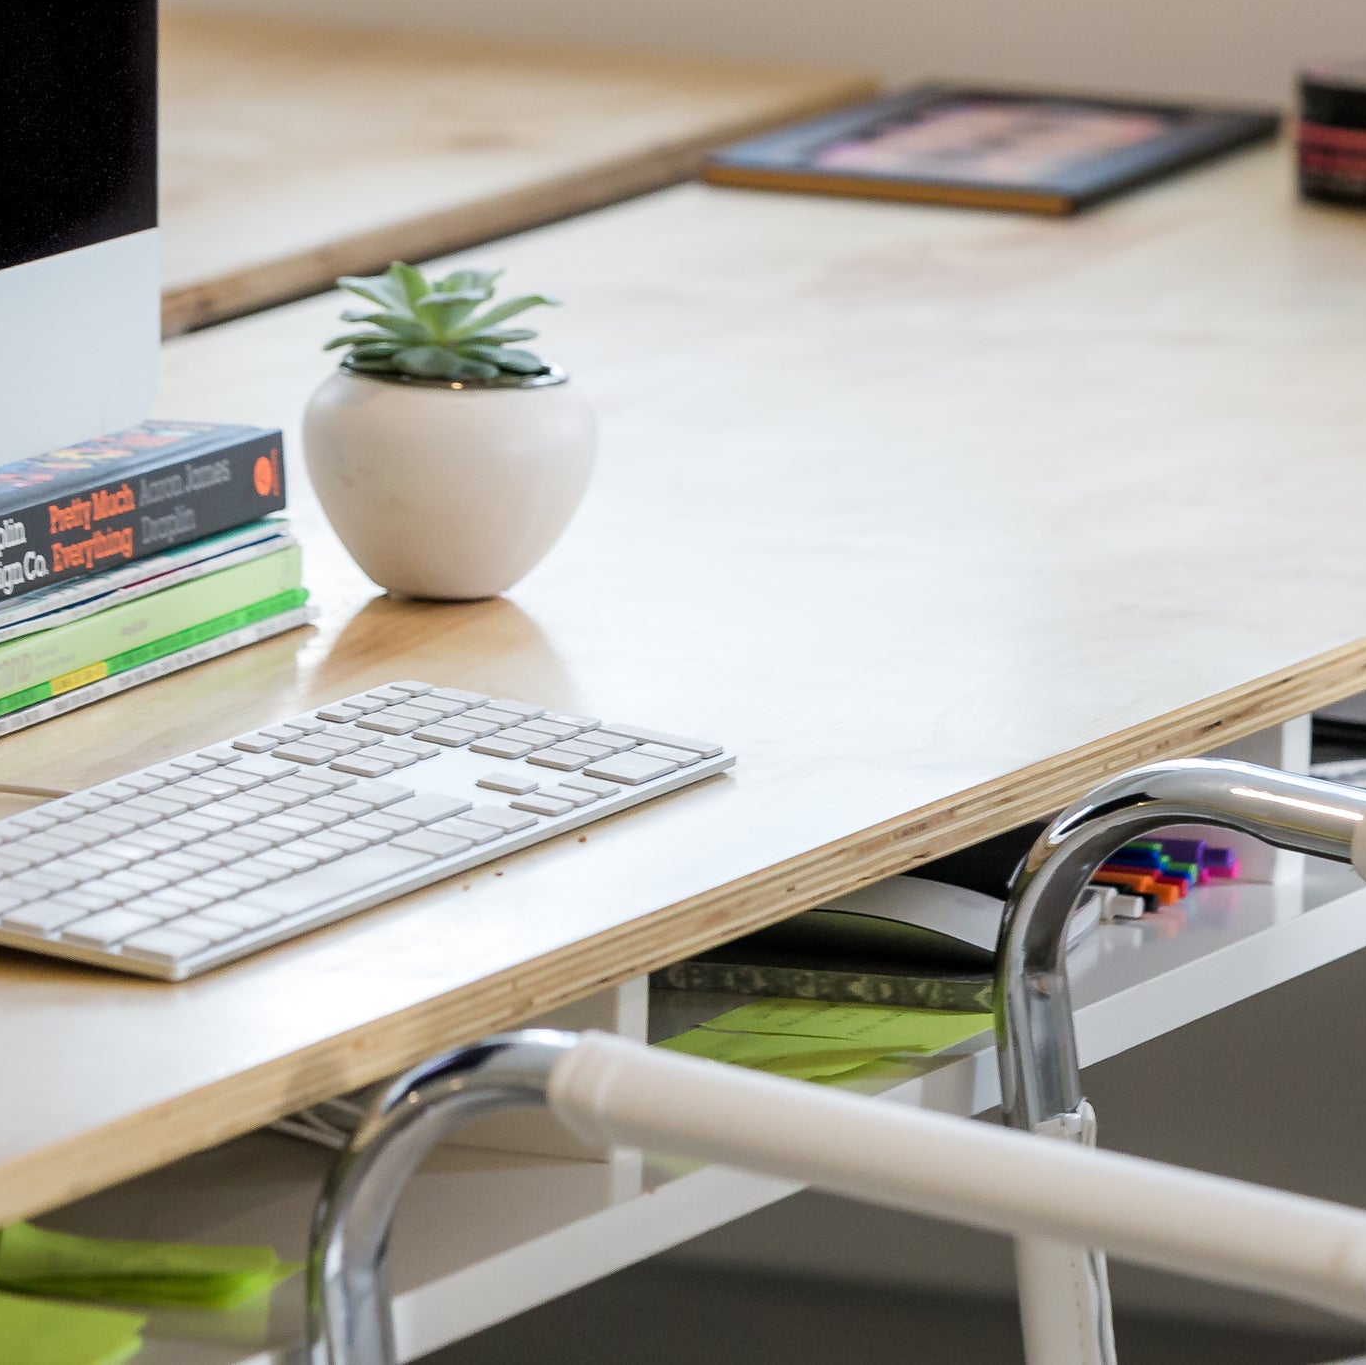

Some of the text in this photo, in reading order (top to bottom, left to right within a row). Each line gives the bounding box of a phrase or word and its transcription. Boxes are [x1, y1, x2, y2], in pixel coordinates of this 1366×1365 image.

[48, 483, 136, 534] Pretty Much
[141, 505, 197, 545] Draplin
[23, 550, 50, 581] Co.
[51, 527, 133, 572] Everything
